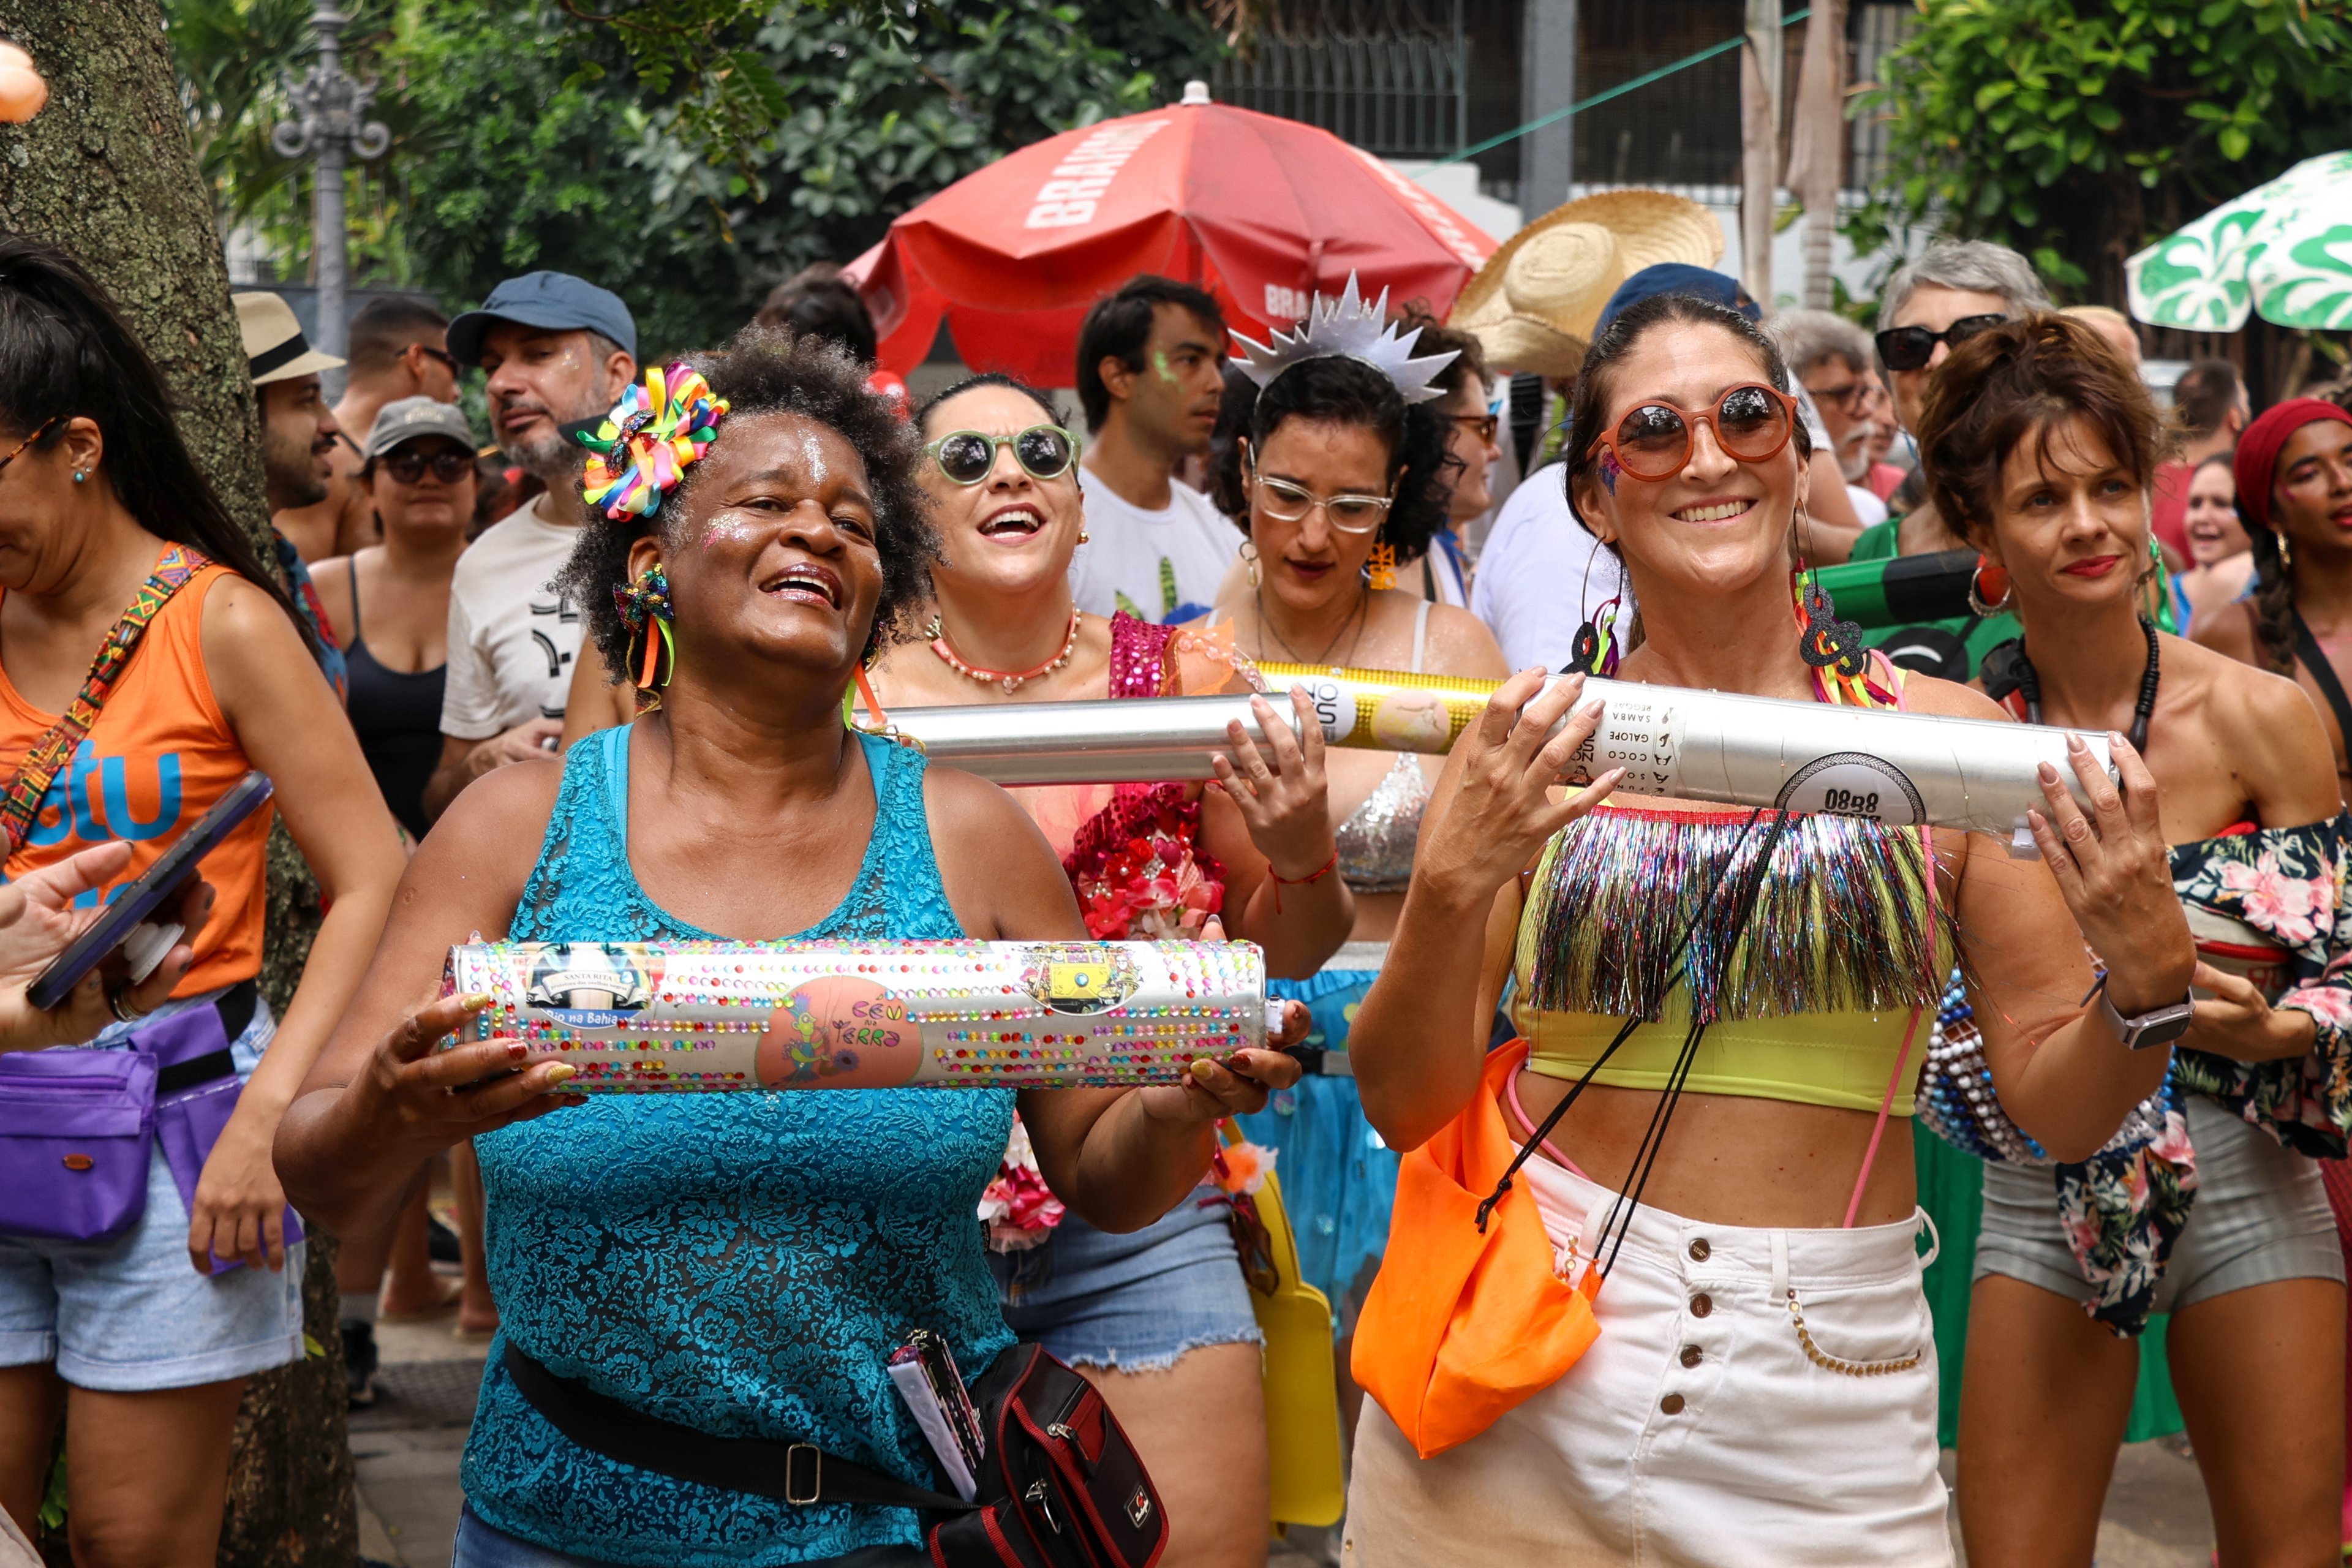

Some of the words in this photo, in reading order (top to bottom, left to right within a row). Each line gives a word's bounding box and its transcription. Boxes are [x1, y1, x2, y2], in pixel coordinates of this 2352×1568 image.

[1613, 702, 1651, 712] REGGAE
[1613, 712, 1651, 723] SAMBA
[1610, 731, 1649, 742] GALOPE
[1608, 751, 1647, 761] COCO
[1825, 789, 1879, 813] 8&80
[568, 1014, 583, 1023] na
[587, 1012, 618, 1025] Bahia
